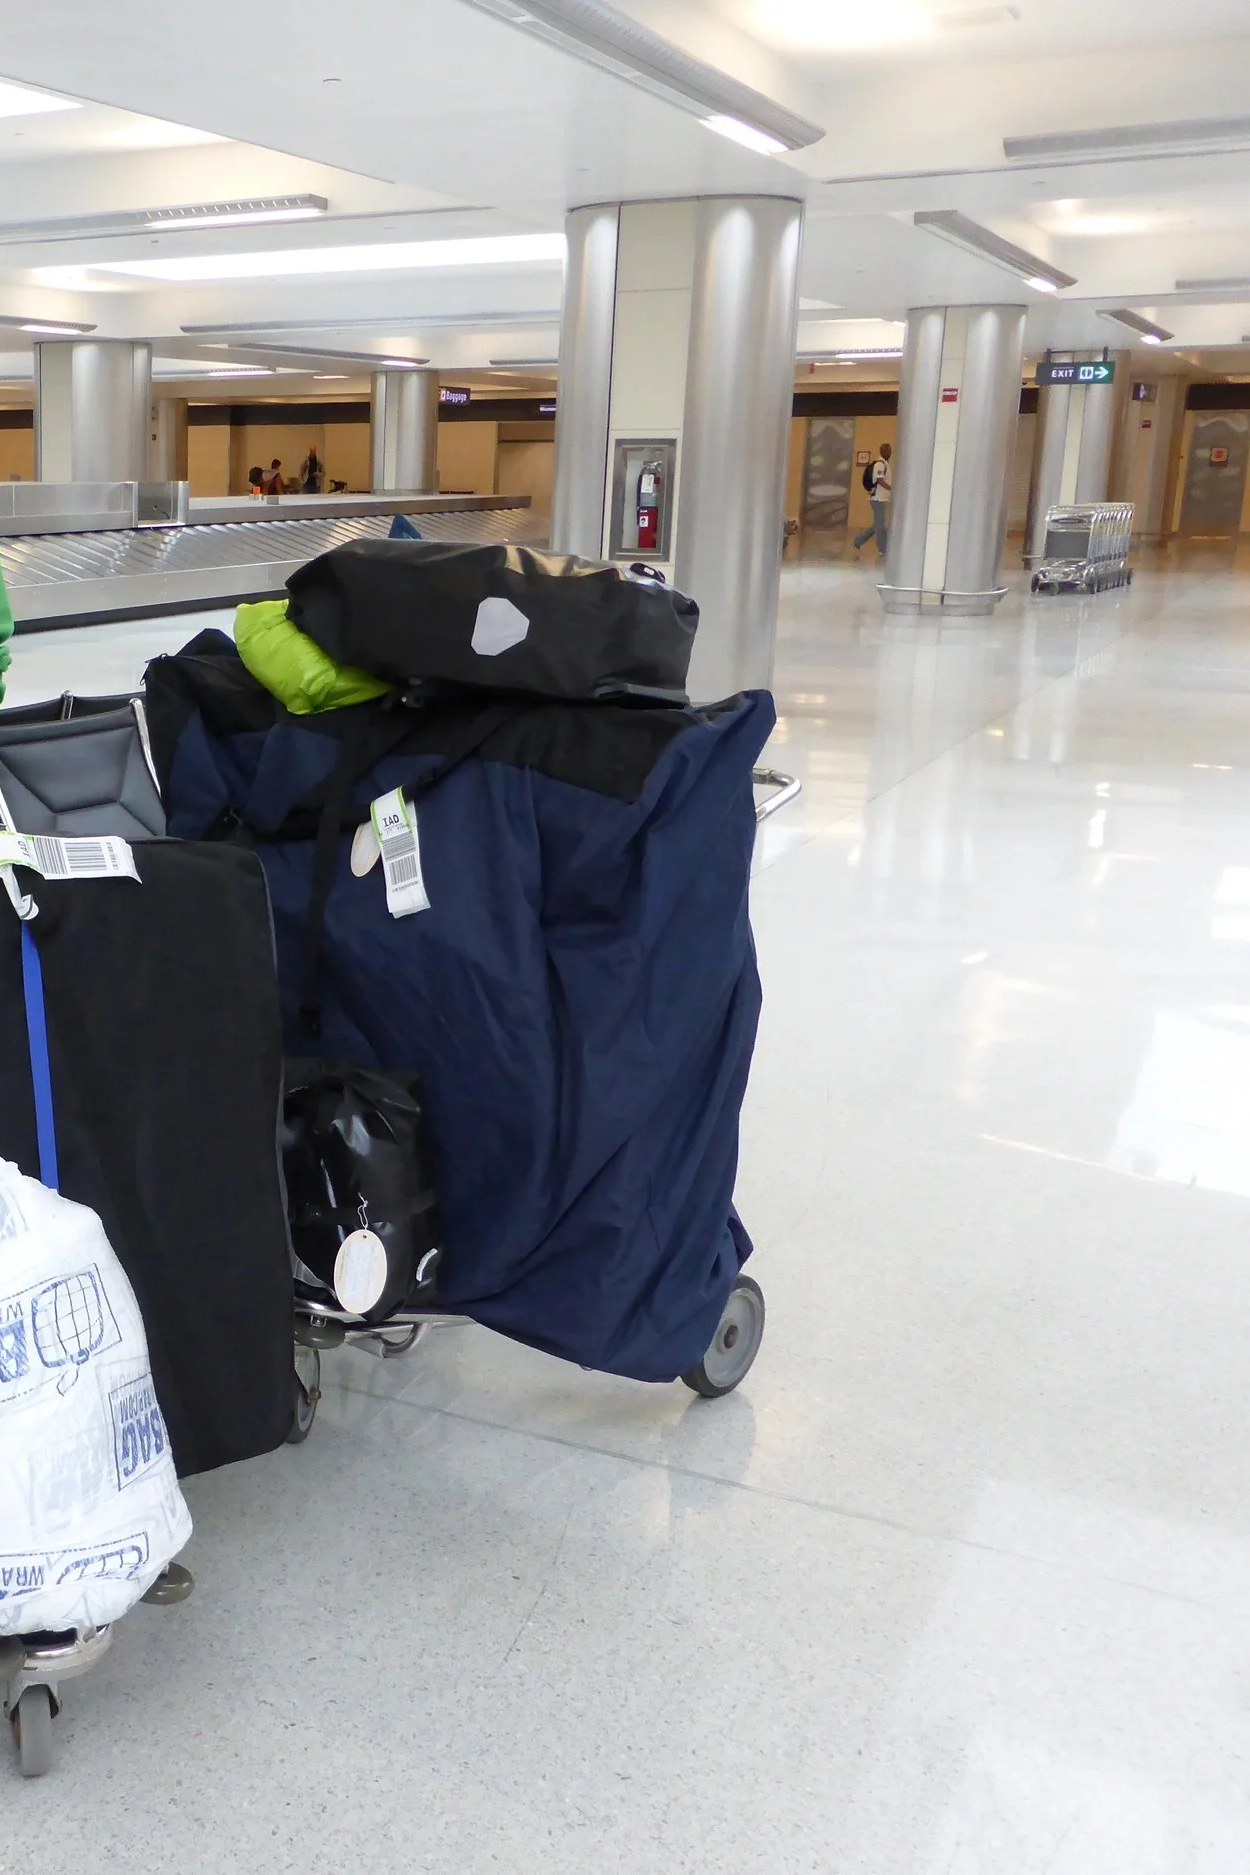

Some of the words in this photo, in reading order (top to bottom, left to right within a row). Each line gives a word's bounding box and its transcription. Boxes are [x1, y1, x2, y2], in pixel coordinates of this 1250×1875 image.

[1051, 369, 1075, 378] EXIT
[446, 390, 467, 403] Baggage
[383, 814, 400, 827] IAD
